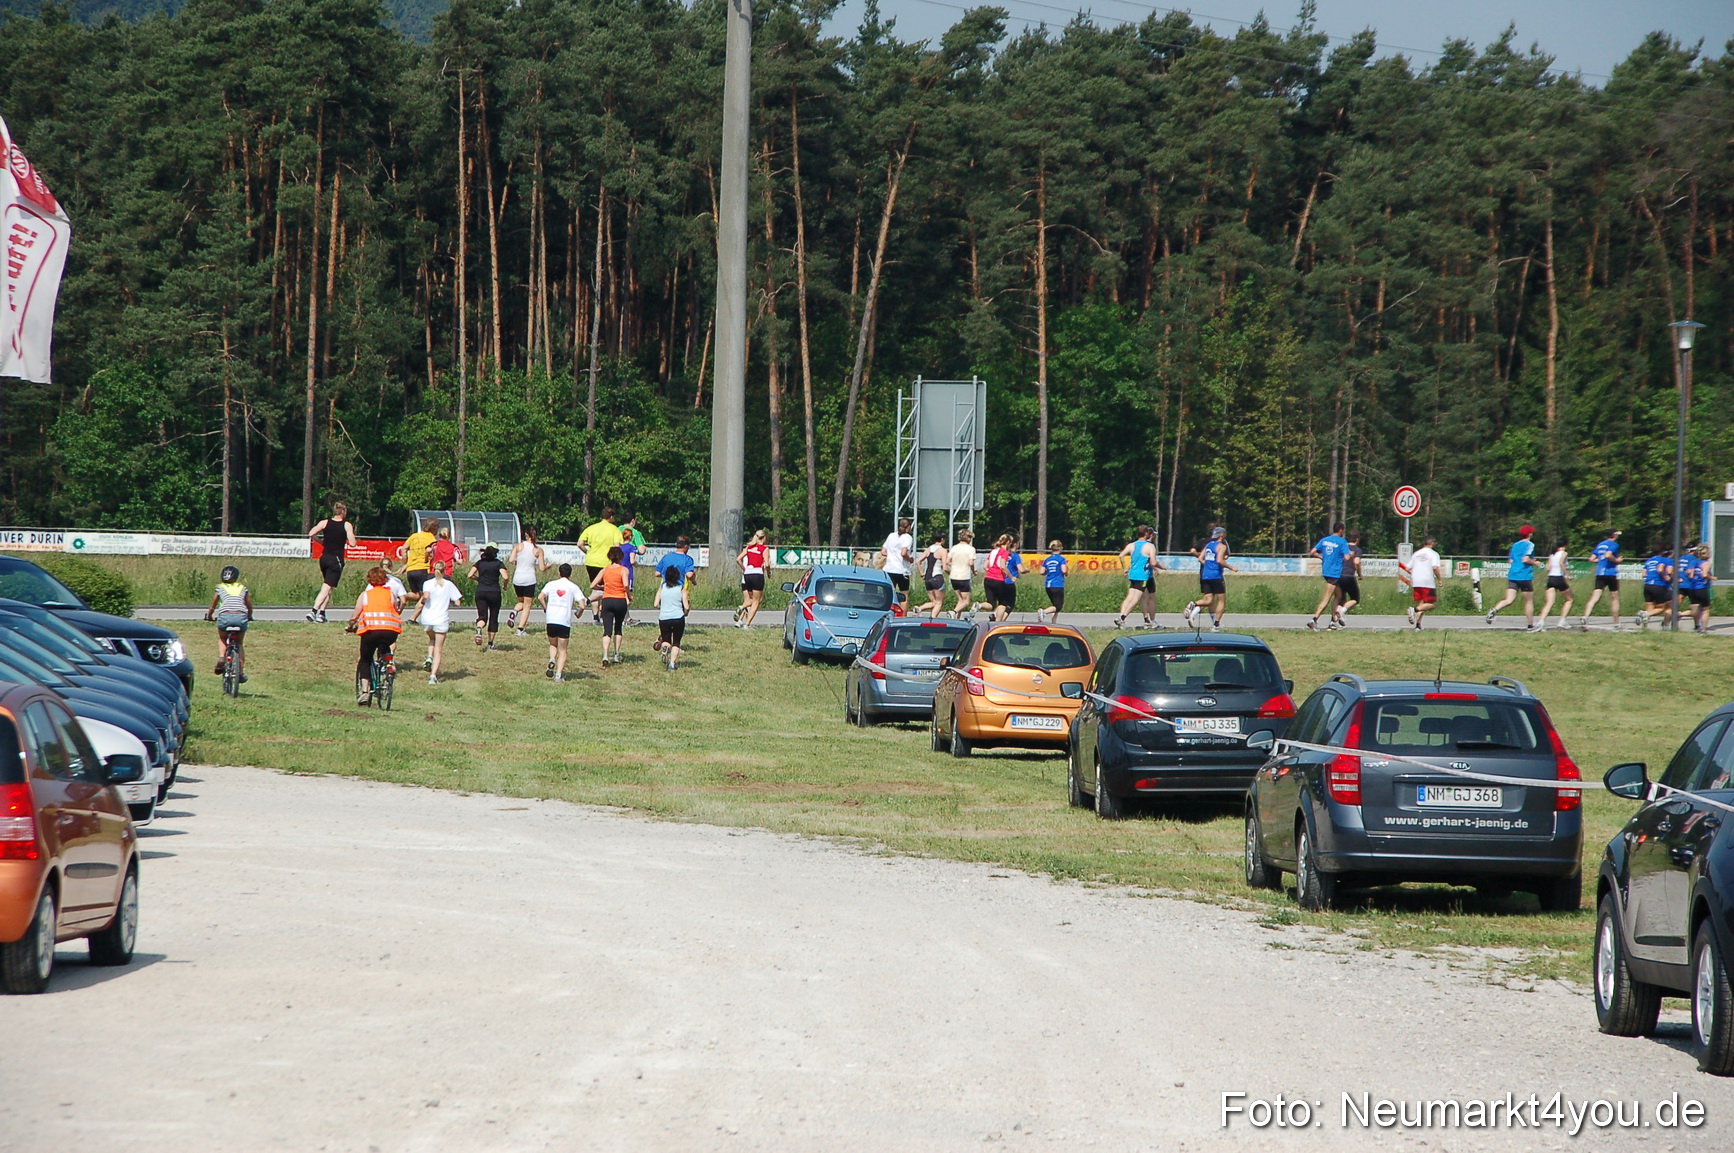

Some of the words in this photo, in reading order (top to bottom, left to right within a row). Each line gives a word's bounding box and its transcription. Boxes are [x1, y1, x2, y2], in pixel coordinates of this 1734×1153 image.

[1400, 495, 1415, 508] 60
[30, 533, 64, 544] DURIN
[234, 545, 308, 556] Reichertshofen
[1017, 717, 1029, 726] NM
[1032, 717, 1044, 726] GJ
[1045, 718, 1061, 727] 229
[1203, 719, 1216, 729] GJ
[1218, 719, 1237, 729] 335
[1176, 737, 1238, 745] www.gerhart-jaenig.de
[1427, 788, 1446, 800] NM
[1453, 788, 1470, 801] GJ
[1474, 788, 1499, 802] 368
[1384, 816, 1529, 830] www.gerhart-jaenig.de
